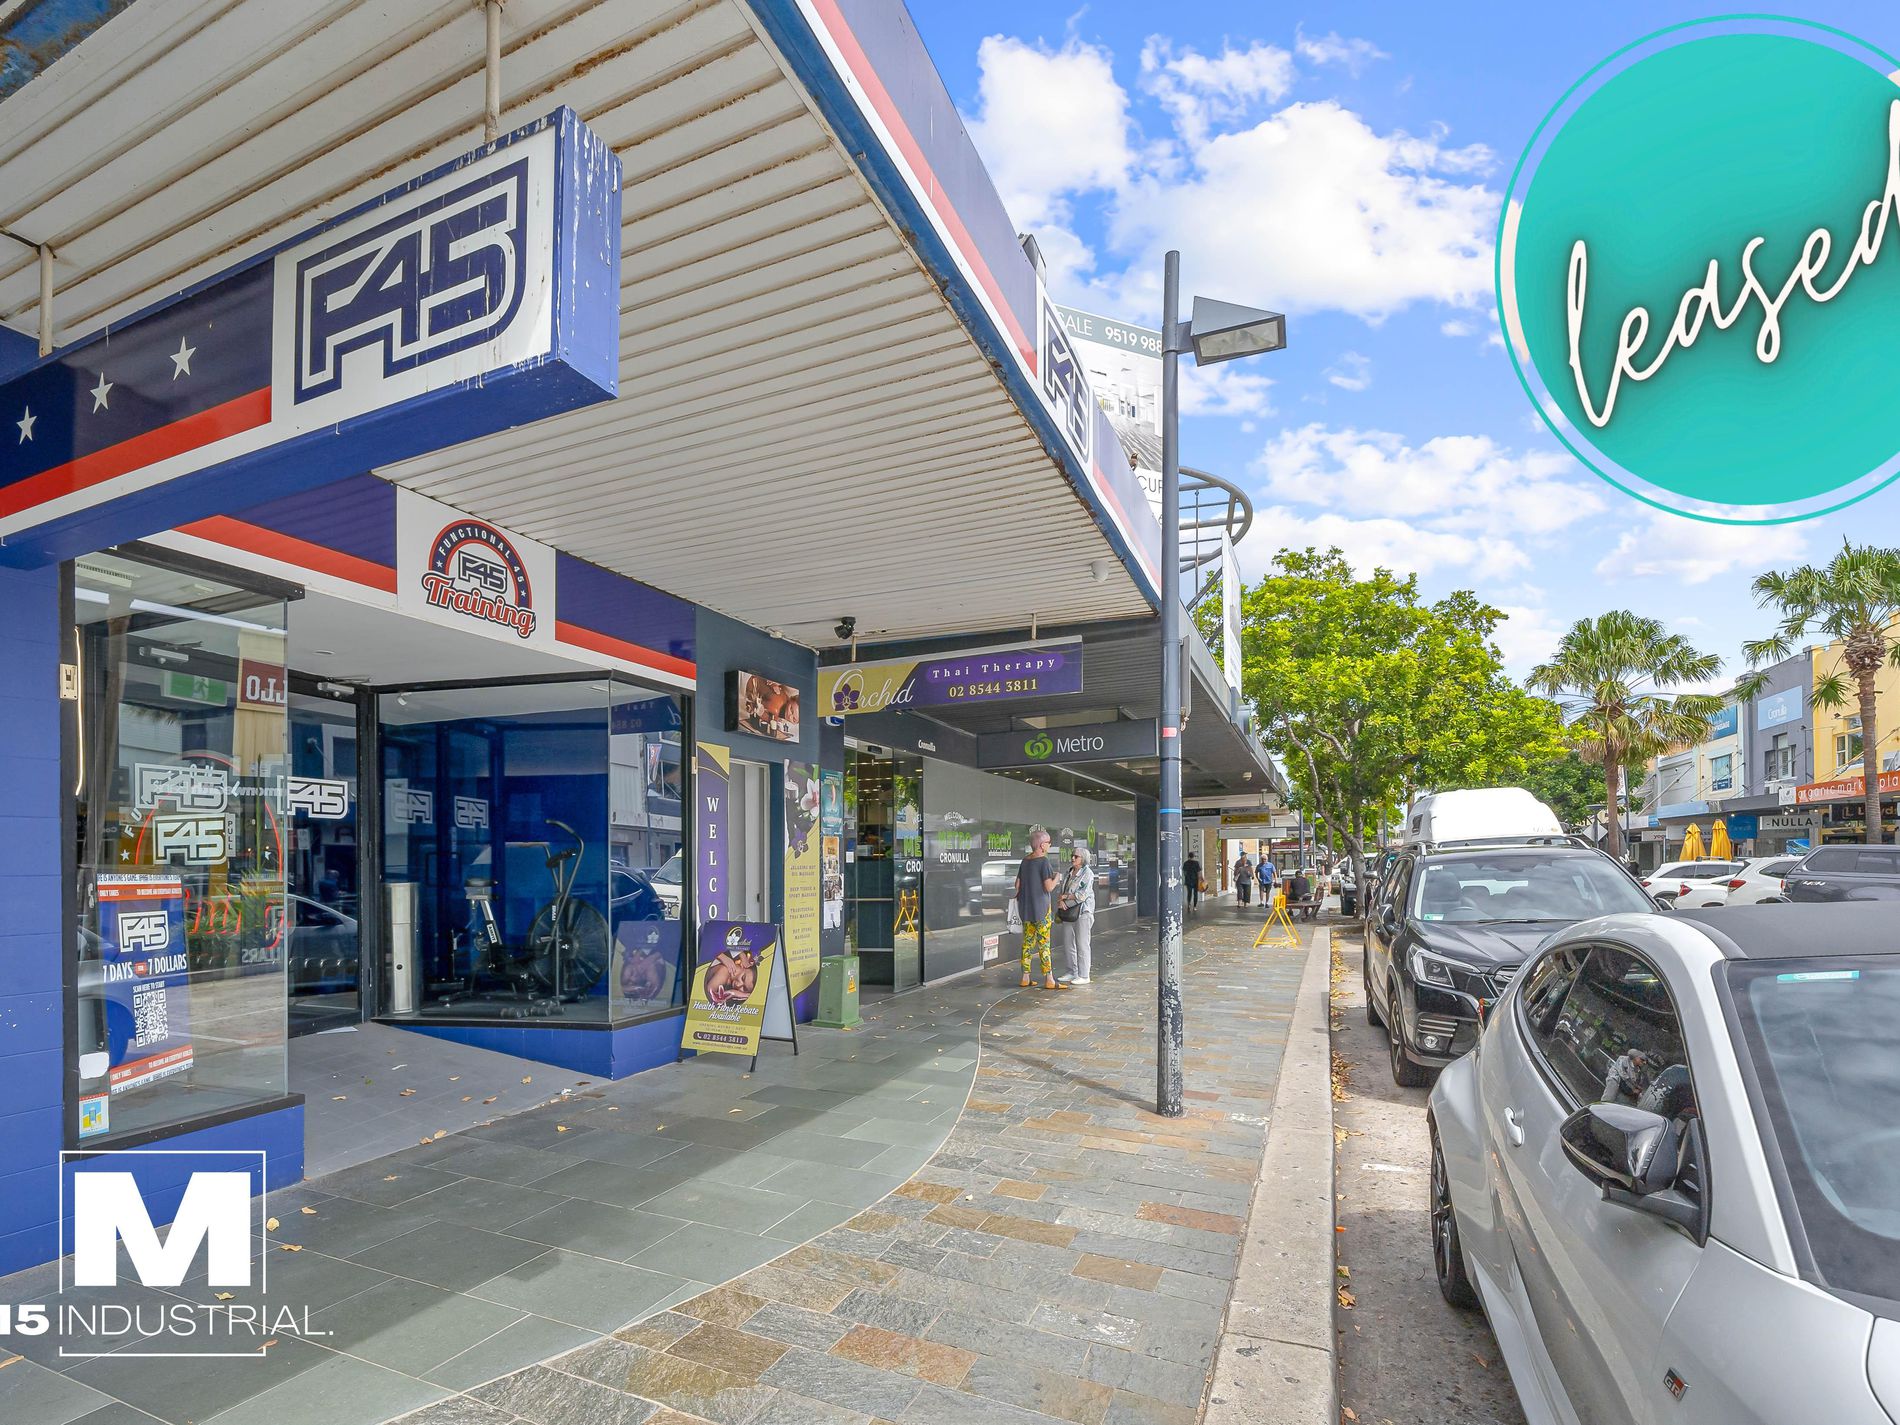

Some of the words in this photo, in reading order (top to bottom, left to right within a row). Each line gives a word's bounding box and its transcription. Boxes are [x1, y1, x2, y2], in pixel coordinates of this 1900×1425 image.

[294, 157, 529, 405] F45
[1105, 326, 1137, 346] 9519
[439, 527, 510, 559] FUNCTIONAL
[458, 549, 507, 594] F45
[422, 573, 536, 638] Training
[933, 666, 969, 679] Thai
[981, 657, 1056, 676] Therapy
[831, 668, 916, 713] Orchid
[949, 685, 964, 698] 02
[969, 682, 1001, 696] 8544
[1005, 678, 1038, 692] 3811
[1056, 735, 1104, 754] Metro
[134, 763, 228, 814] F45
[277, 775, 348, 819] F45
[153, 814, 226, 865] F45
[940, 852, 969, 863] CRONULLA
[118, 911, 169, 952] F45
[102, 965, 107, 983] 7
[109, 962, 134, 982] DAYS
[148, 959, 153, 975] 7
[154, 954, 187, 974] DOLLARS
[692, 1001, 715, 1011] Health
[709, 1011, 741, 1022] Available
